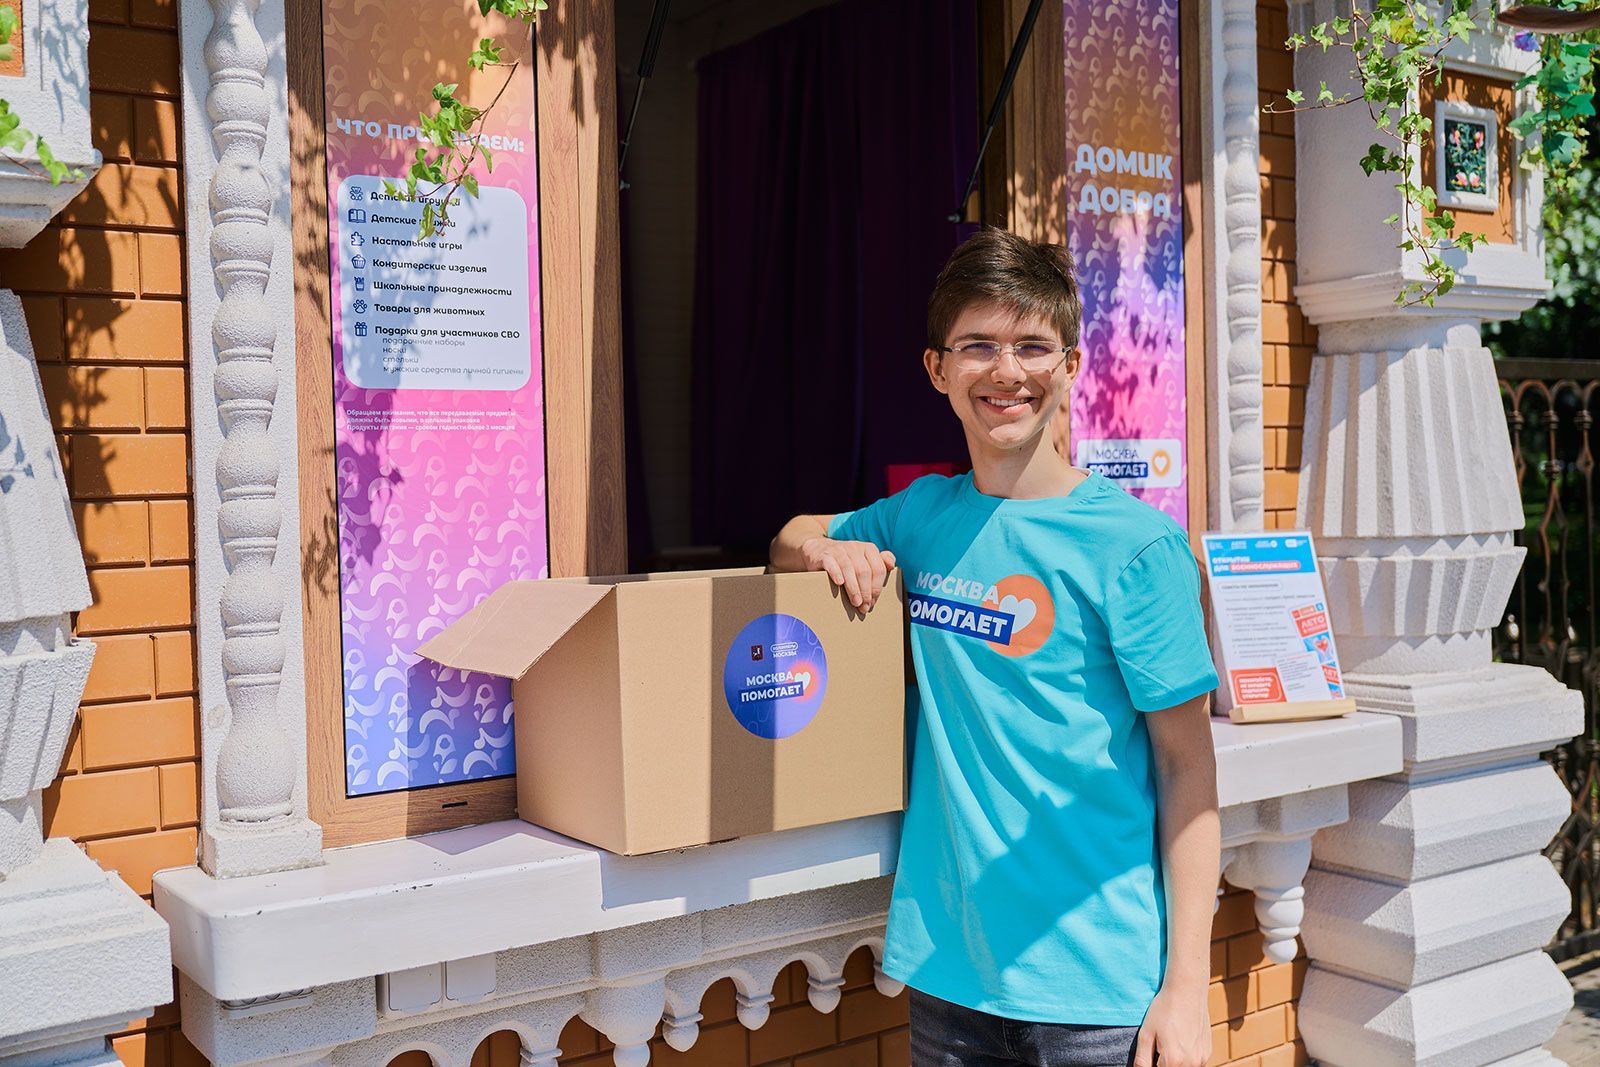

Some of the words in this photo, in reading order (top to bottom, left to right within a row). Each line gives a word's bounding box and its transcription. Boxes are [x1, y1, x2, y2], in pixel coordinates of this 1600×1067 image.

[336, 118, 382, 138] ЧТО
[1075, 143, 1173, 180] ДОМИК
[418, 196, 460, 207] игруи
[1079, 184, 1171, 219] ДОБРА
[371, 213, 417, 225] Детские
[372, 236, 437, 249] Настольные
[438, 242, 463, 251] игры
[372, 259, 447, 271] Кондитерские
[448, 264, 487, 274] изделия
[373, 281, 426, 292] Школьные
[427, 286, 512, 296] принадлежности
[374, 303, 411, 314] Товары
[413, 306, 431, 315] для
[433, 307, 485, 316] животных
[375, 326, 418, 337] Подарки
[420, 328, 438, 337] для
[440, 329, 499, 338] участников
[500, 330, 520, 339] СВО
[382, 337, 433, 346] подарочные
[434, 338, 466, 347] наборы
[382, 356, 419, 364] стельки
[383, 366, 419, 375] мужские
[421, 366, 461, 374] средства
[462, 365, 492, 375] личной
[346, 409, 381, 417] Обращаем
[1096, 448, 1139, 460] МОСКВА
[916, 571, 999, 605] МОСКВА
[909, 598, 1008, 637] ОМОГАЕТ
[746, 671, 794, 687] МОСКВА
[741, 684, 801, 702] ПОМОГАЕТ
